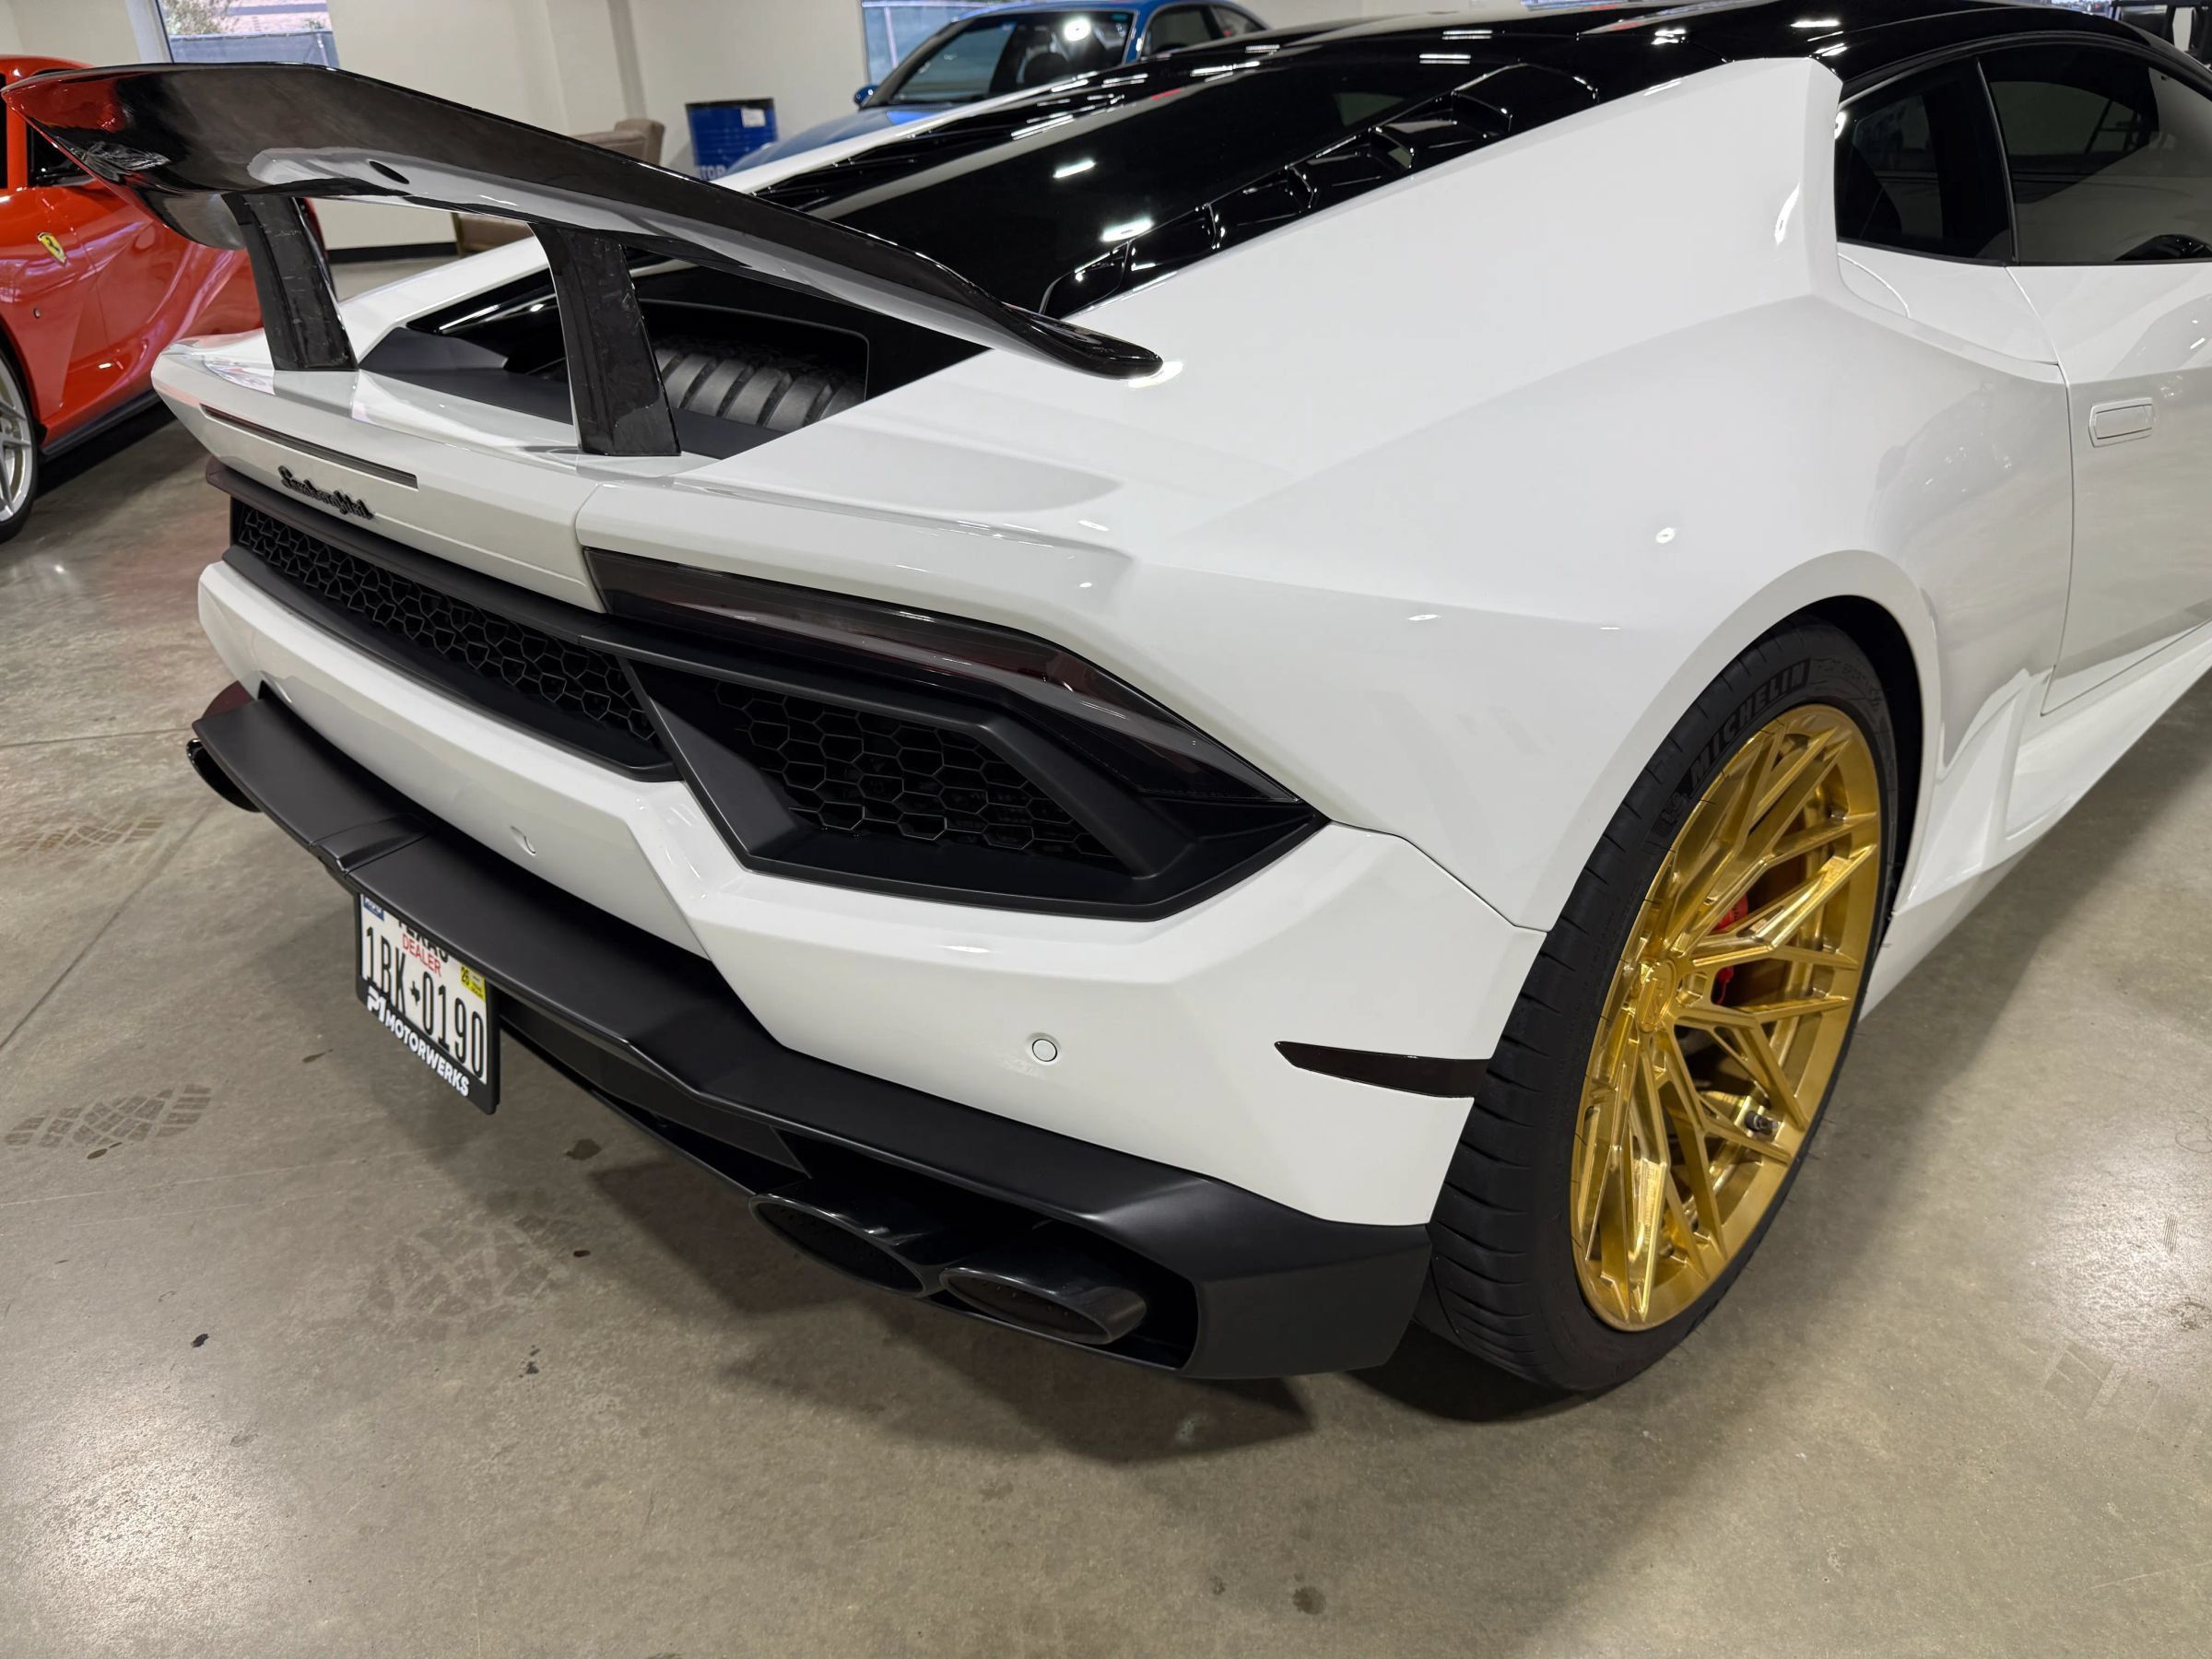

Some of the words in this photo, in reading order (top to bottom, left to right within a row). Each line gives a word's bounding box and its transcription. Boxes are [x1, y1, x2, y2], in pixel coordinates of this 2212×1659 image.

[1688, 661, 1807, 786] MICHELIN
[366, 926, 406, 1015] 1BK
[422, 971, 485, 1079] 0190
[402, 933, 441, 978] DEALER
[367, 986, 386, 1023] P1
[385, 1008, 469, 1098] MOTORWERKS
